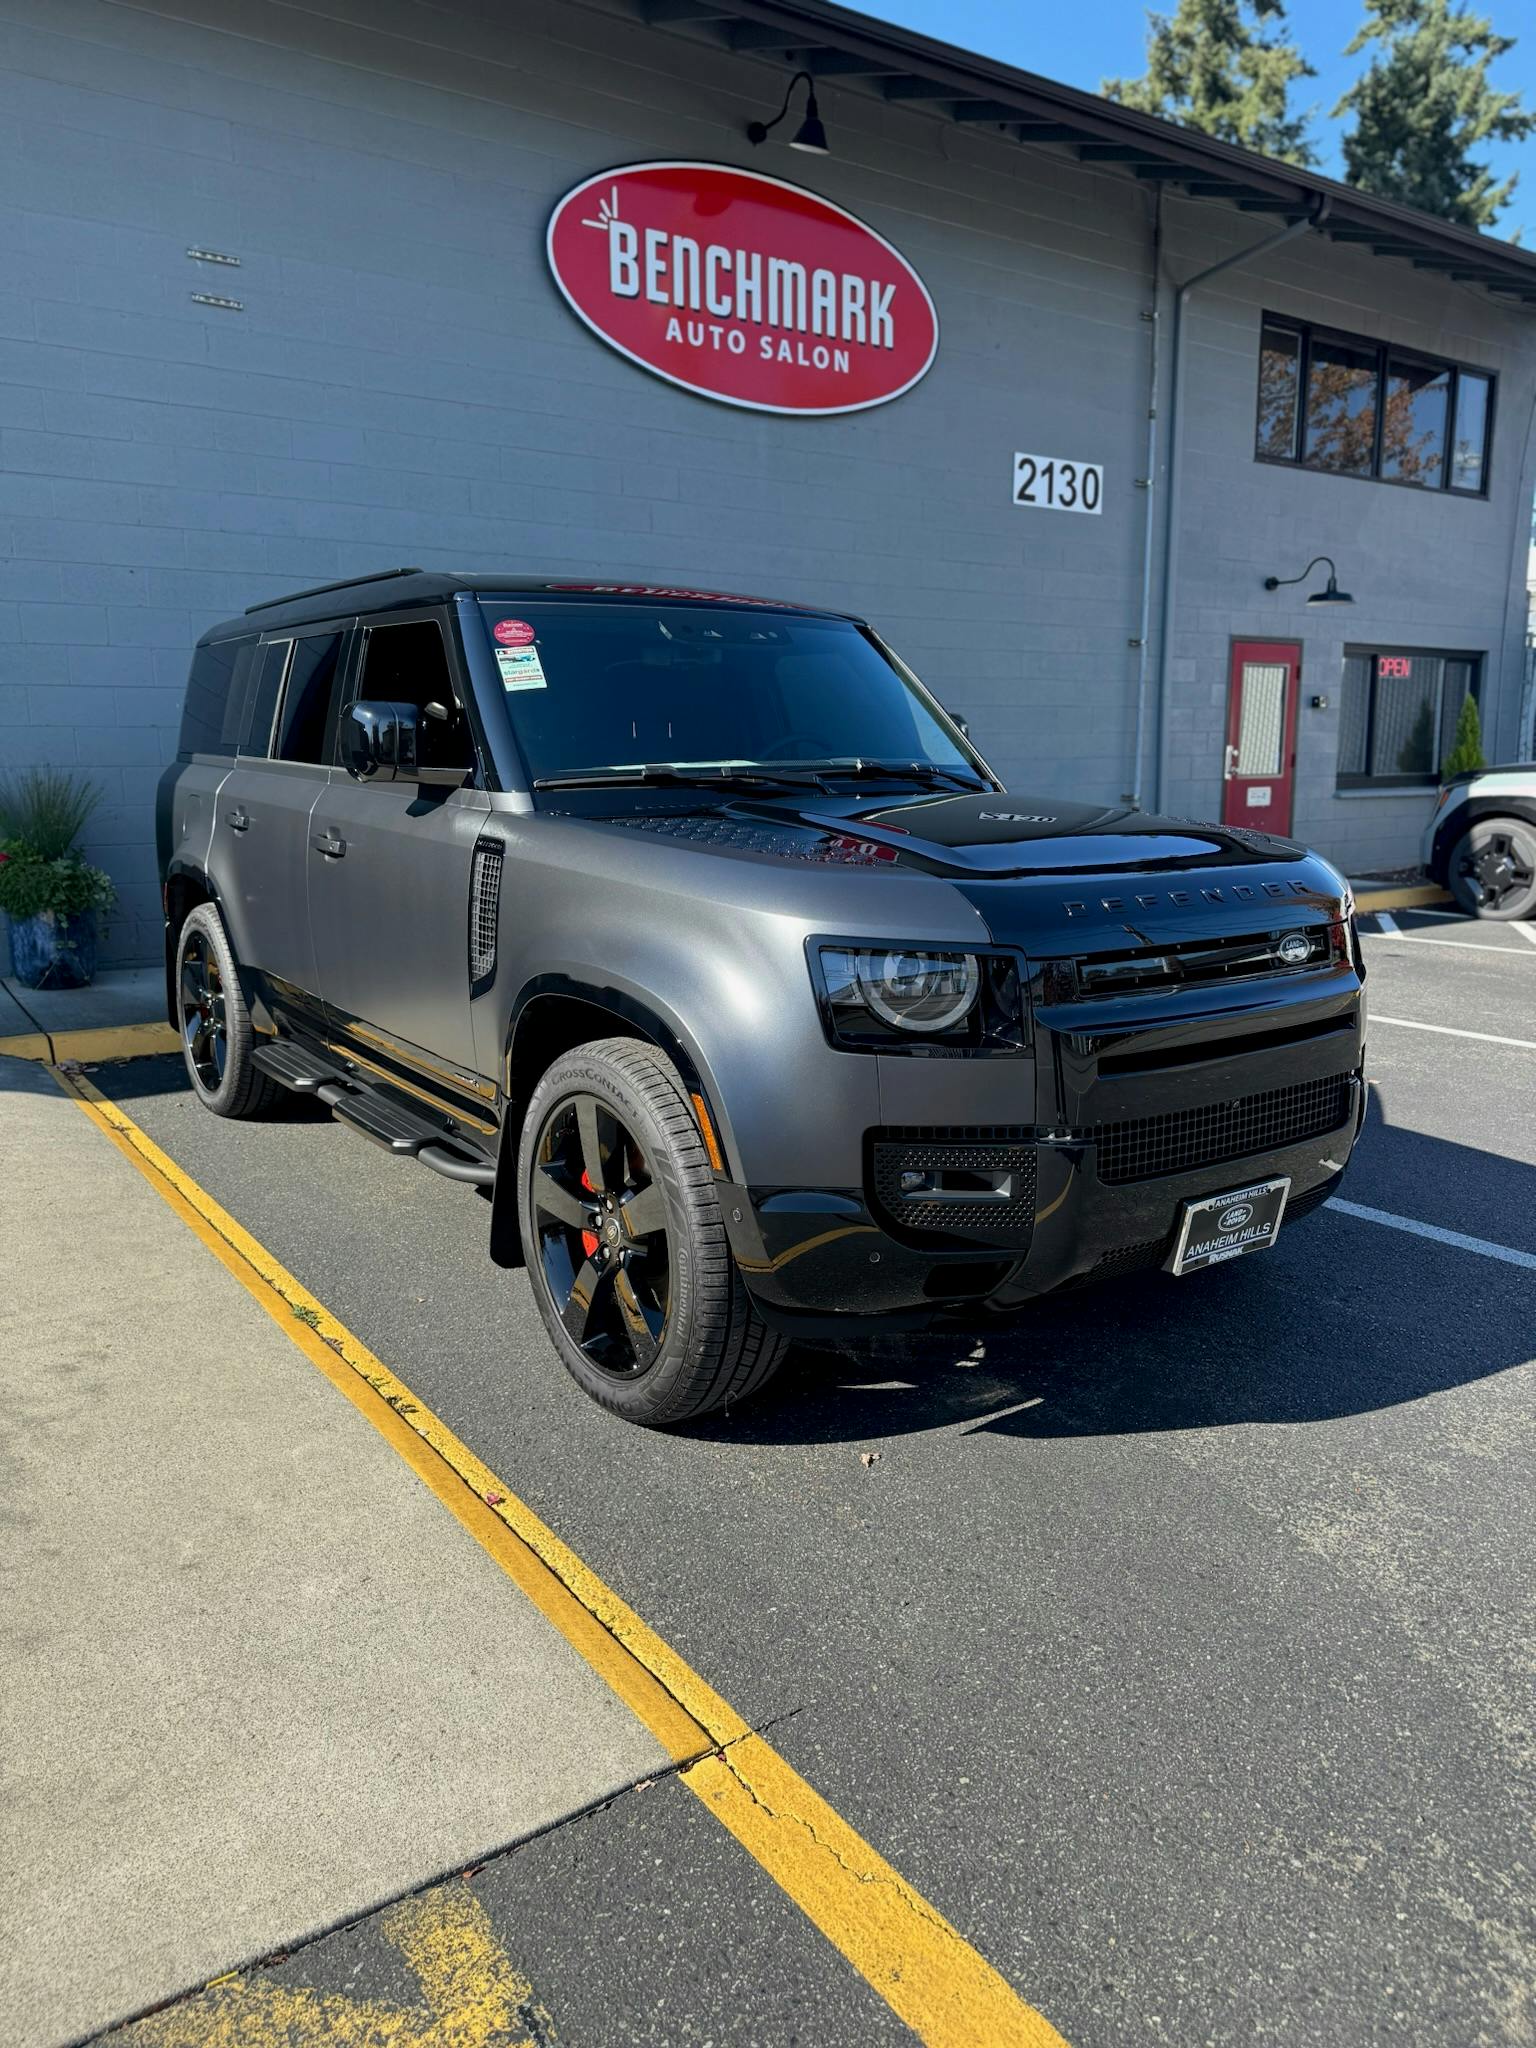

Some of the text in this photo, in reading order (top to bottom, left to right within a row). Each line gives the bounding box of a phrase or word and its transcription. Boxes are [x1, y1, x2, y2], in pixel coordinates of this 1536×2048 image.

[609, 220, 896, 349] BENCHMARK
[666, 318, 850, 374] AUTO SALON
[1017, 458, 1099, 510] 2130
[1378, 657, 1409, 677] OPEN
[1063, 880, 1311, 918] DEFENDER
[1215, 1187, 1267, 1208] ANAHEIM HILLS
[1186, 1223, 1271, 1258] ANAHEIM HILLS
